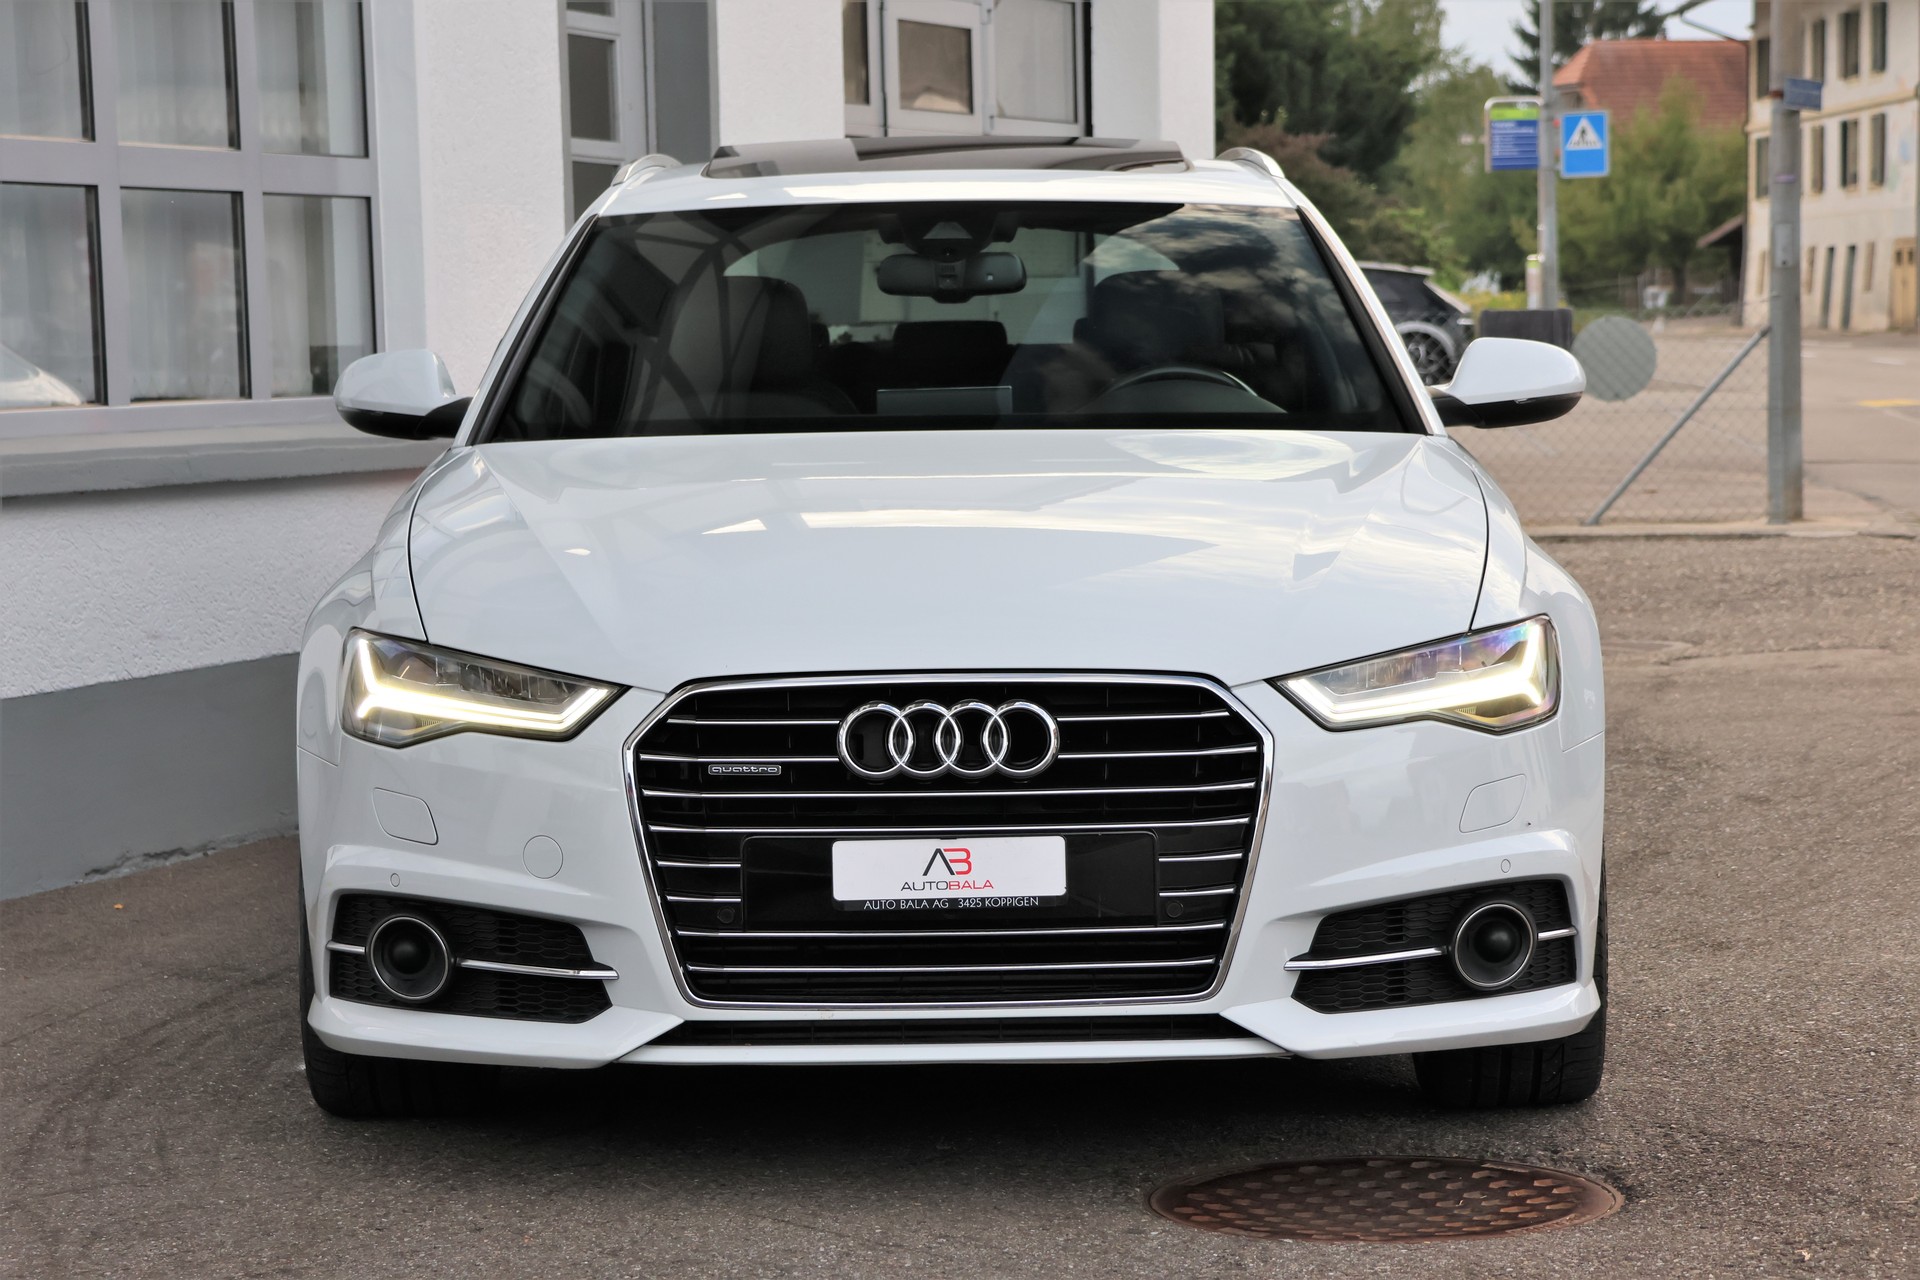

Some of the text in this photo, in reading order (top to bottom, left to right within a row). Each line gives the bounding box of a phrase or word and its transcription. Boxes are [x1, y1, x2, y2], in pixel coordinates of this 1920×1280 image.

[711, 765, 778, 774] quattro
[900, 880, 994, 892] AUTOBALA
[863, 896, 1039, 910] AUTO BALA AG 3425 KOPPIGEN
